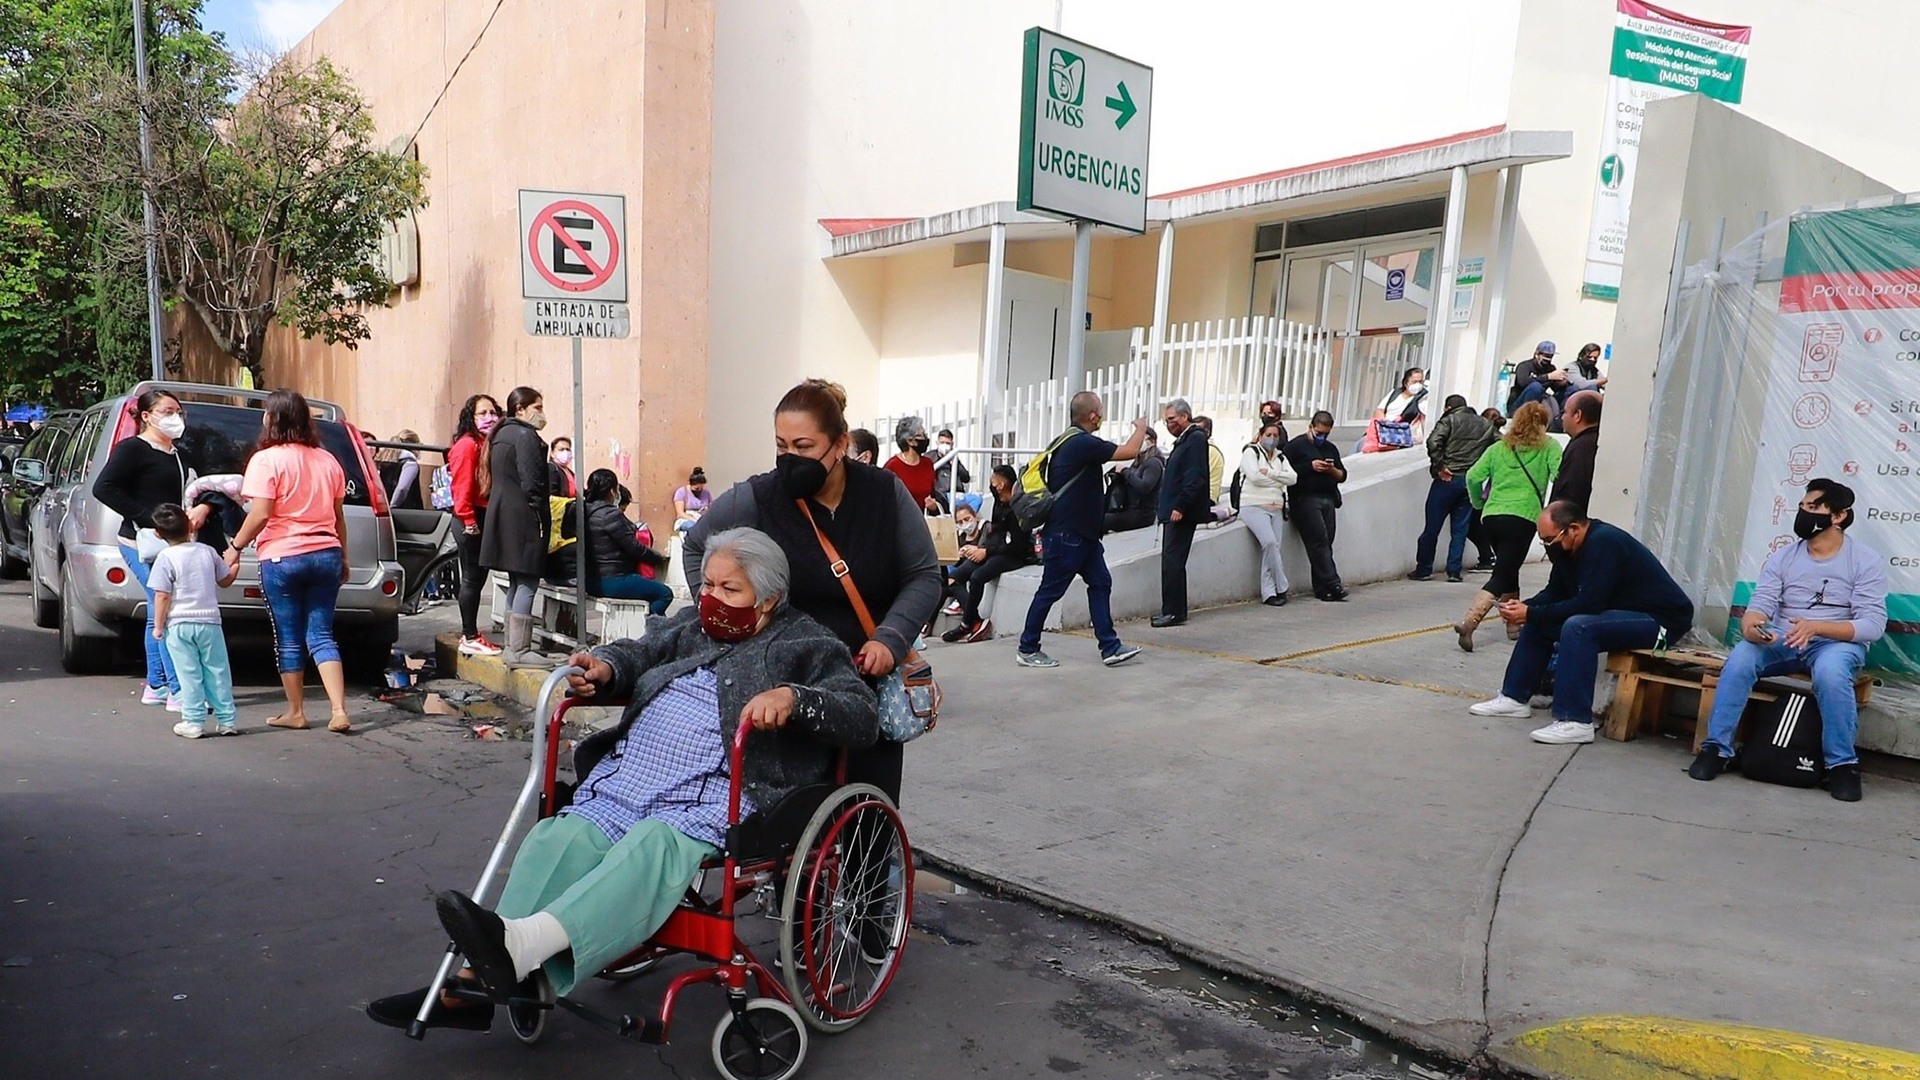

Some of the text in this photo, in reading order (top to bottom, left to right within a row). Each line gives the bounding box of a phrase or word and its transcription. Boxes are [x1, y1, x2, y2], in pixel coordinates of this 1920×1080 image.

[1644, 23, 1672, 36] unidad
[1673, 30, 1700, 44] médica
[1645, 40, 1718, 66] Módulo de Atención
[1625, 49, 1733, 82] Respiratoria del Seguro Social
[1659, 69, 1699, 90] (MARSS)
[1045, 98, 1084, 129] IMSS
[1039, 141, 1141, 195] URGENCIAS
[1812, 282, 1920, 300] Por tu prop
[536, 301, 615, 319] ENTRADA DE
[535, 320, 617, 338] AMBULANCIA
[1899, 328, 1920, 342] Co
[1889, 400, 1904, 414] Si
[1877, 463, 1910, 477] Usa
[1867, 507, 1920, 525] Respe
[1889, 556, 1920, 568] cas
